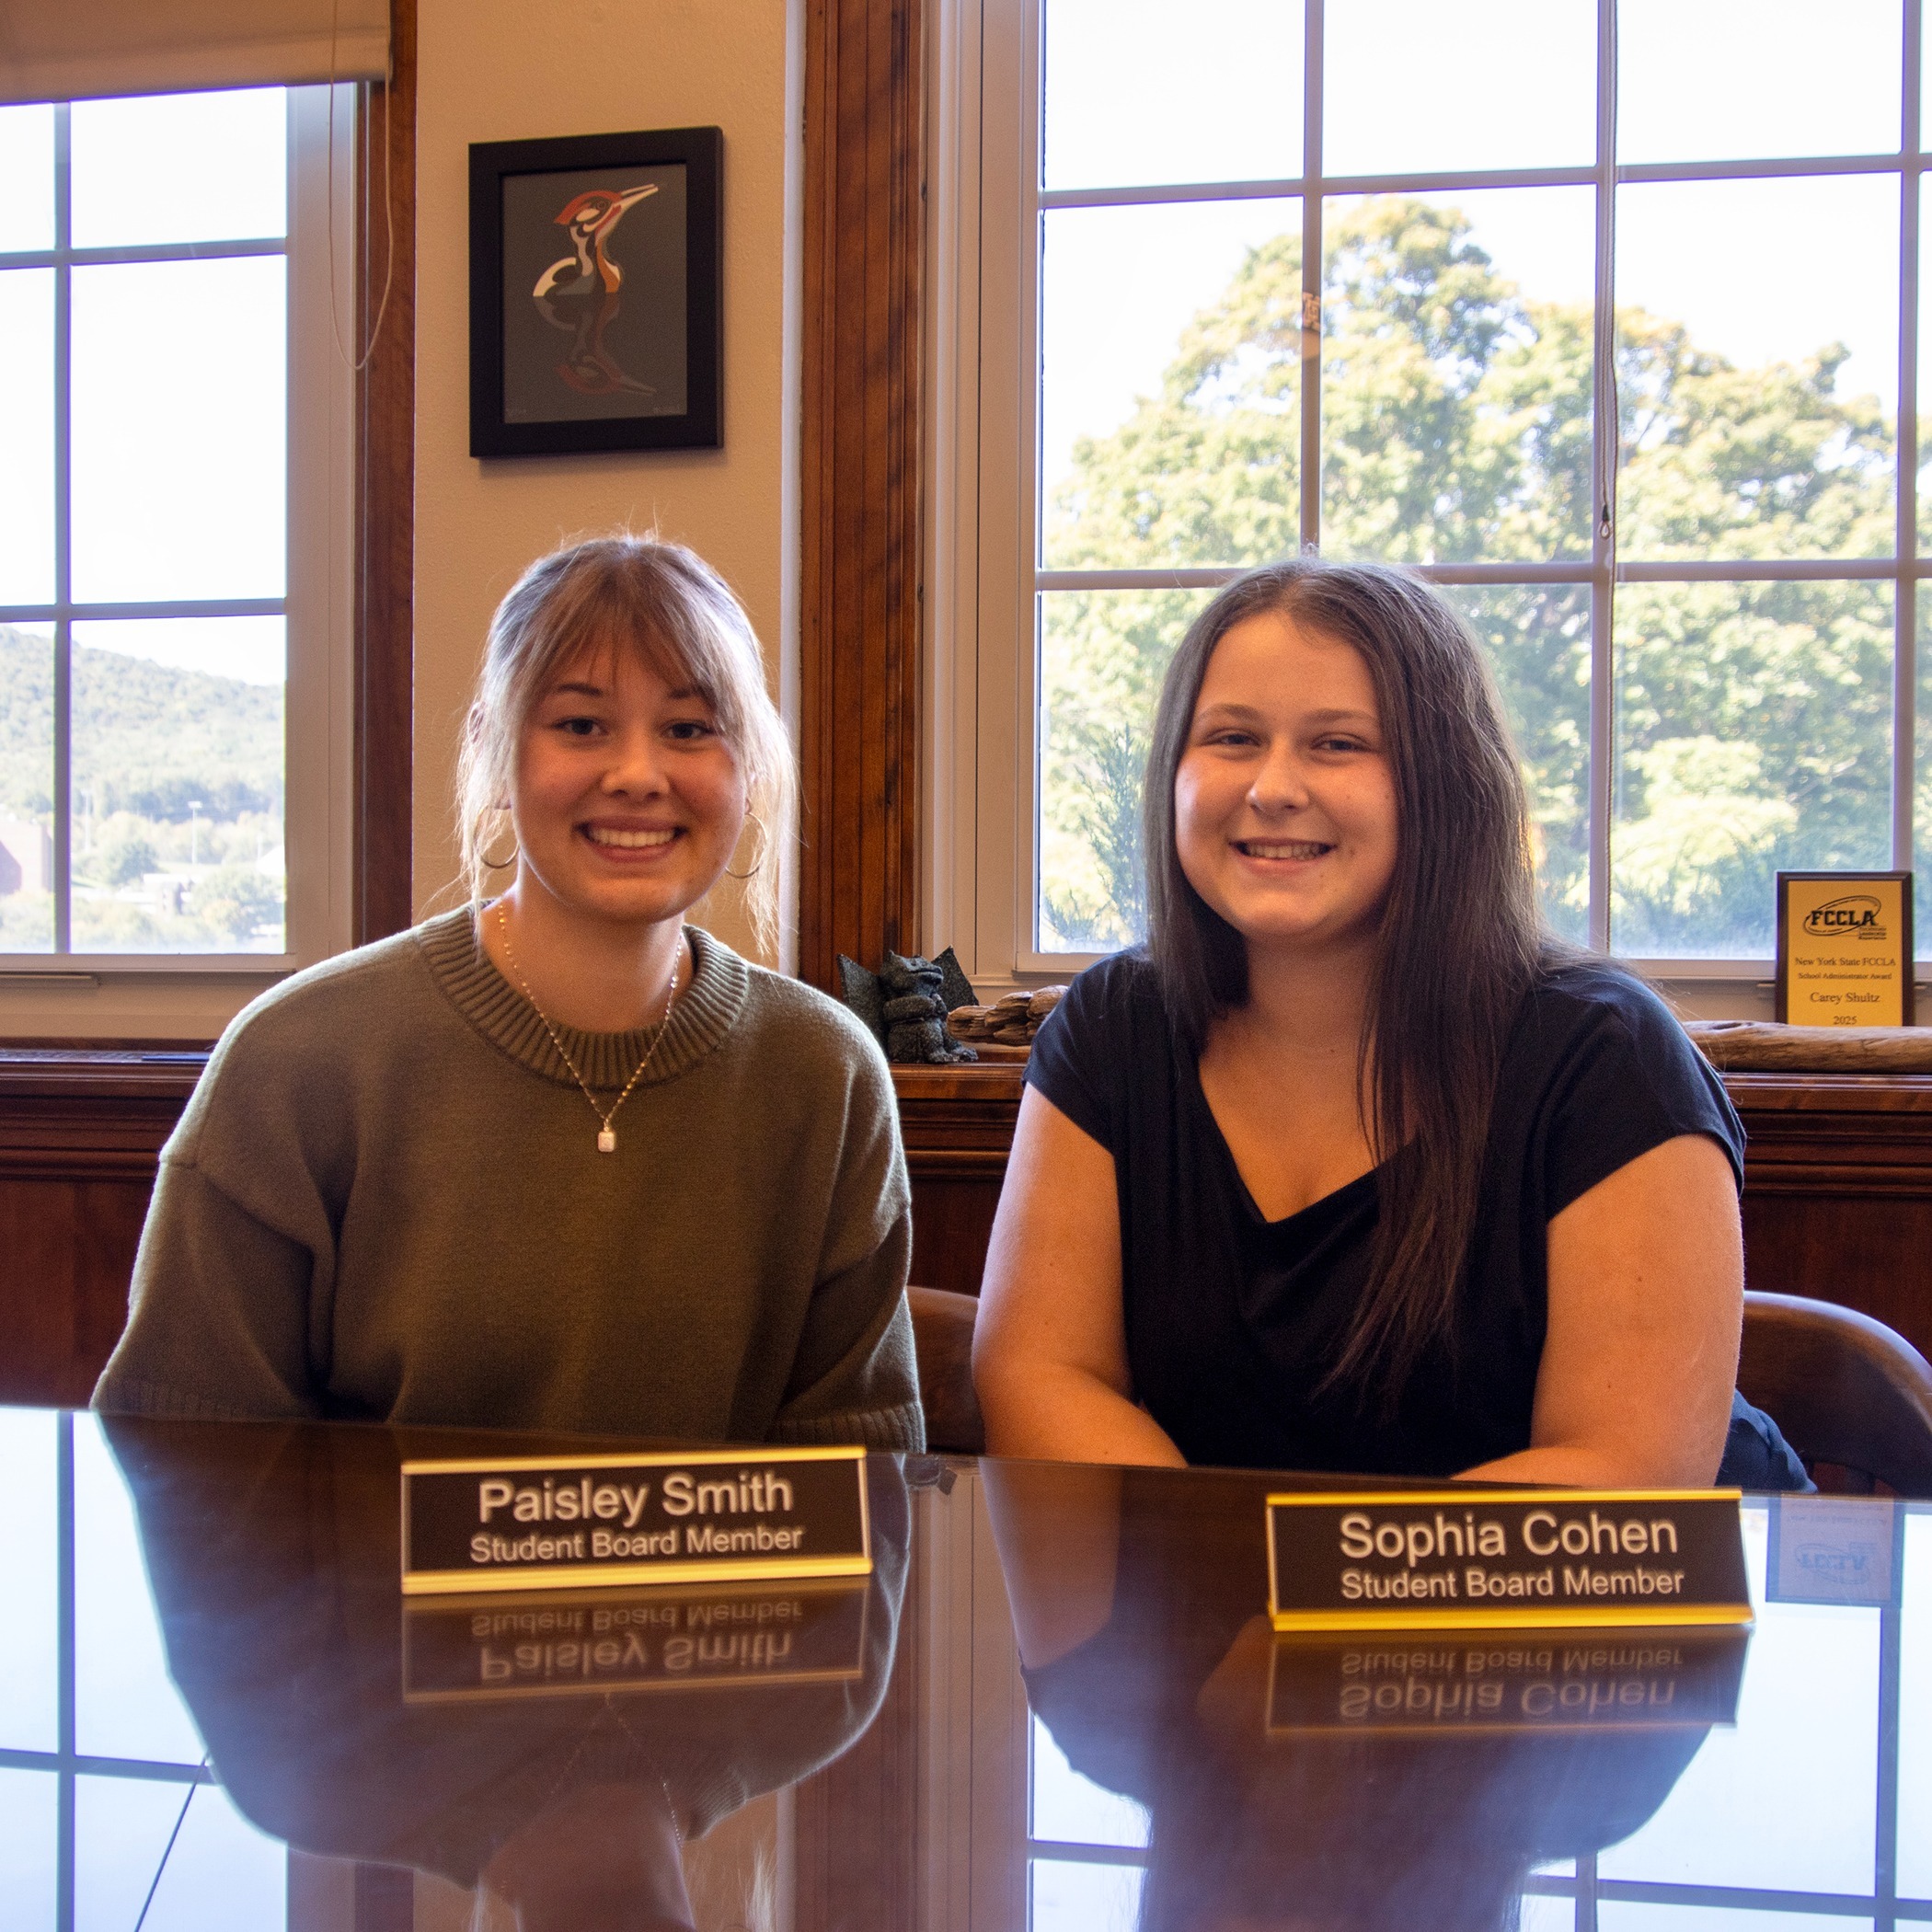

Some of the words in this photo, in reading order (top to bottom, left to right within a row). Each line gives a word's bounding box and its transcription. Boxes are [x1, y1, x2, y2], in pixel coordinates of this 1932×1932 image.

[1811, 910, 1877, 926] FCCLA
[1795, 957, 1814, 966] New
[1817, 957, 1836, 966] York
[1840, 957, 1860, 966] State
[1862, 957, 1896, 966] FCCLA
[1810, 992, 1843, 1005] Carey
[1846, 992, 1880, 1003] Shultz
[1833, 1016, 1857, 1025] 2025
[477, 1476, 648, 1528] Paisley
[661, 1470, 793, 1517] Smith
[470, 1533, 586, 1564] Student
[591, 1528, 678, 1558] Board
[685, 1524, 803, 1554] Member
[1339, 1512, 1506, 1567] Sophia
[1523, 1510, 1678, 1558] Cohen
[1340, 1569, 1457, 1600] Student
[1465, 1568, 1554, 1597] Board
[1563, 1566, 1685, 1596] Member
